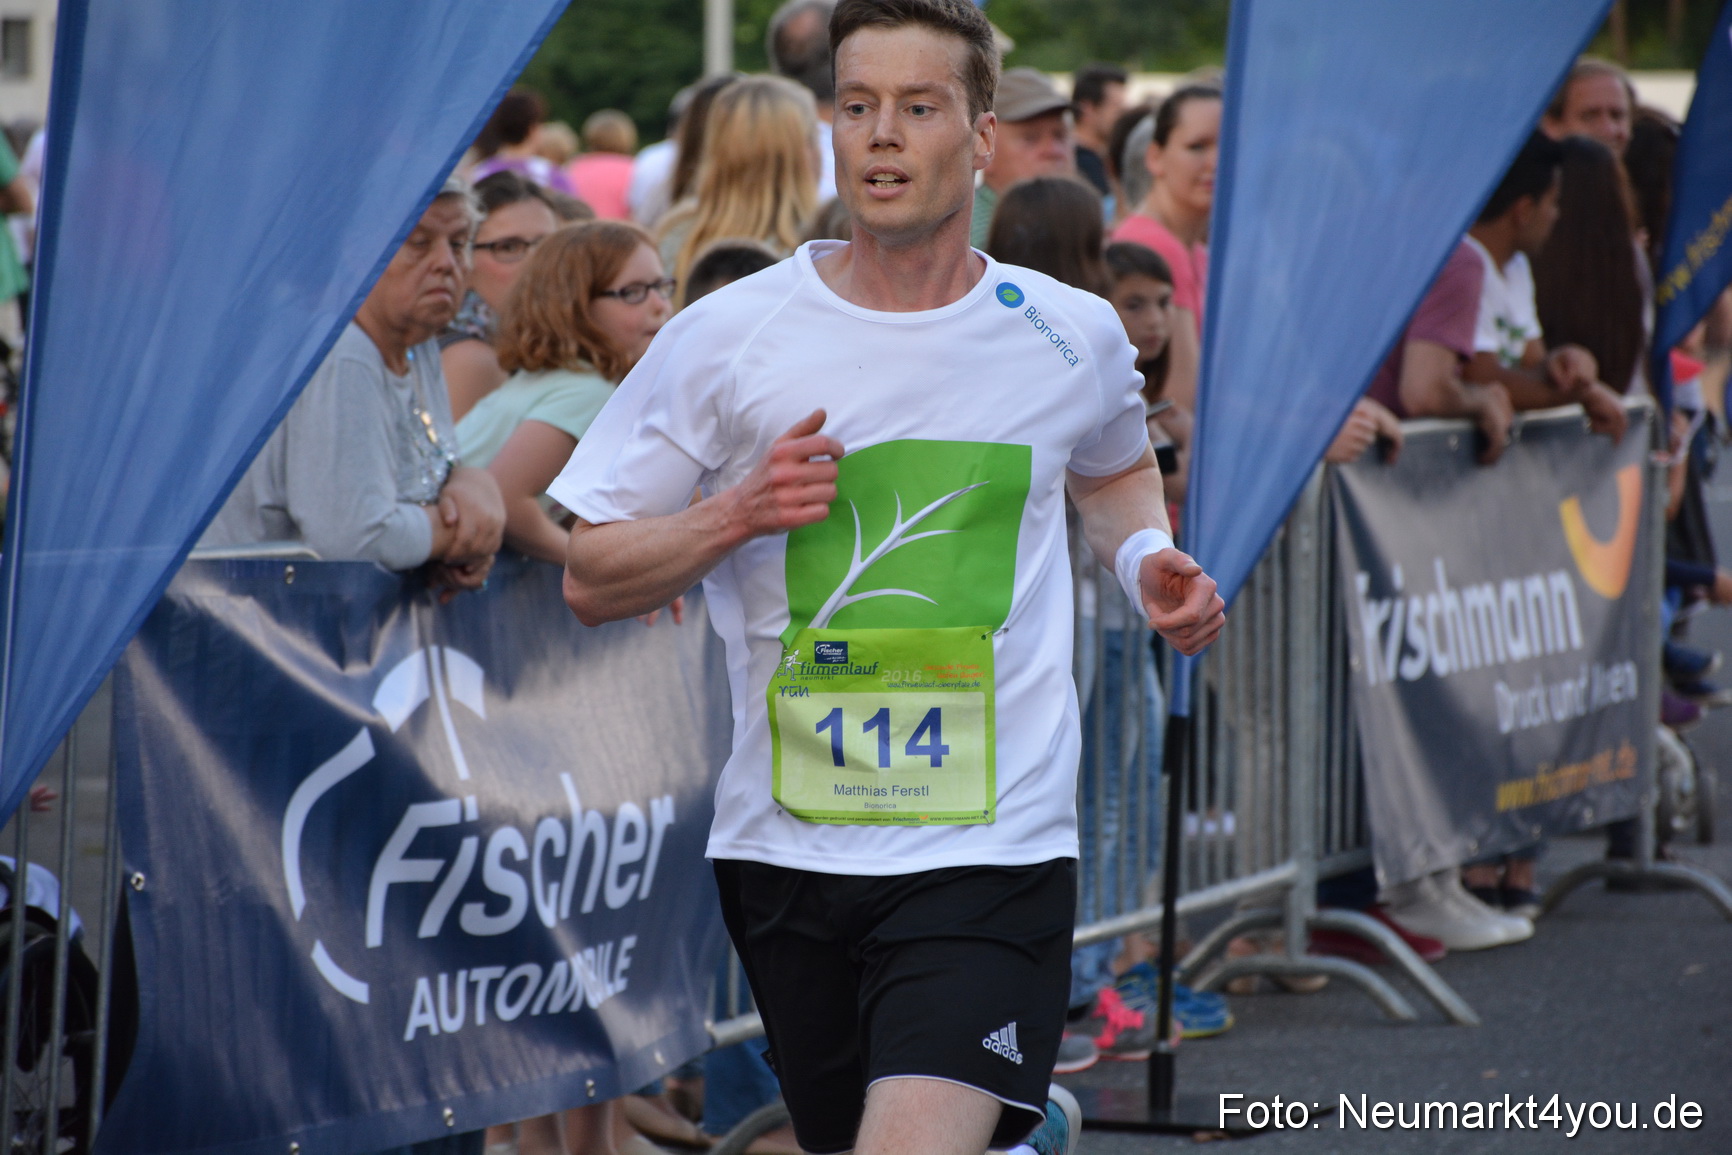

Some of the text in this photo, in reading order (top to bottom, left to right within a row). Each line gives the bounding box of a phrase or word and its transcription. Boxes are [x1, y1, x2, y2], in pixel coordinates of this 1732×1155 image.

[1024, 305, 1079, 367] Bionorica
[800, 661, 879, 675] firmenlauf
[881, 670, 922, 682] 2016
[1549, 662, 1589, 723] und
[815, 707, 950, 768] 114
[834, 784, 929, 797] Matthias Ferstl
[365, 772, 675, 948] Fischer
[982, 1038, 1023, 1065] adidas
